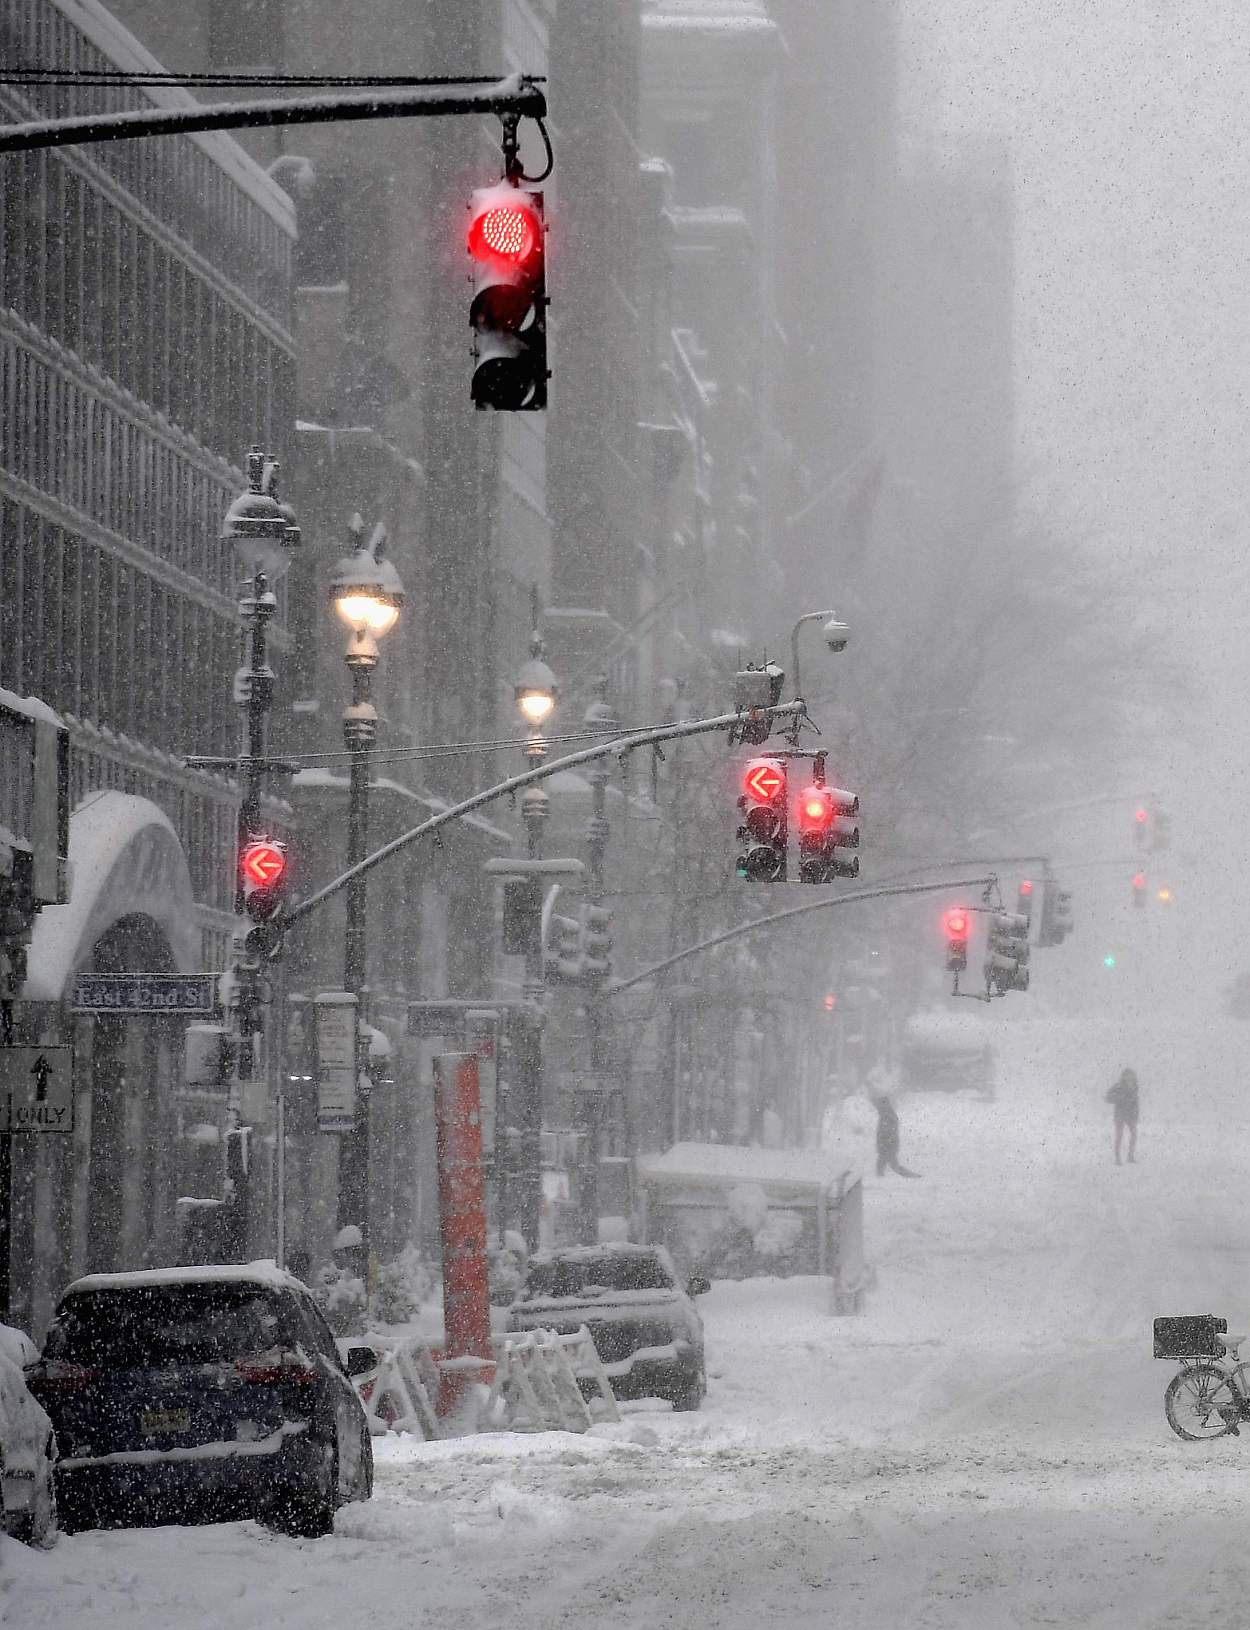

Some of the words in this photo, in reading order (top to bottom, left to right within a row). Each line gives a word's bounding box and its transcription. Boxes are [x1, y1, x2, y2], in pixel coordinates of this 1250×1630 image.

[78, 987, 121, 1005] East
[130, 986, 178, 1006] 42nd
[17, 1107, 66, 1124] ONLY
